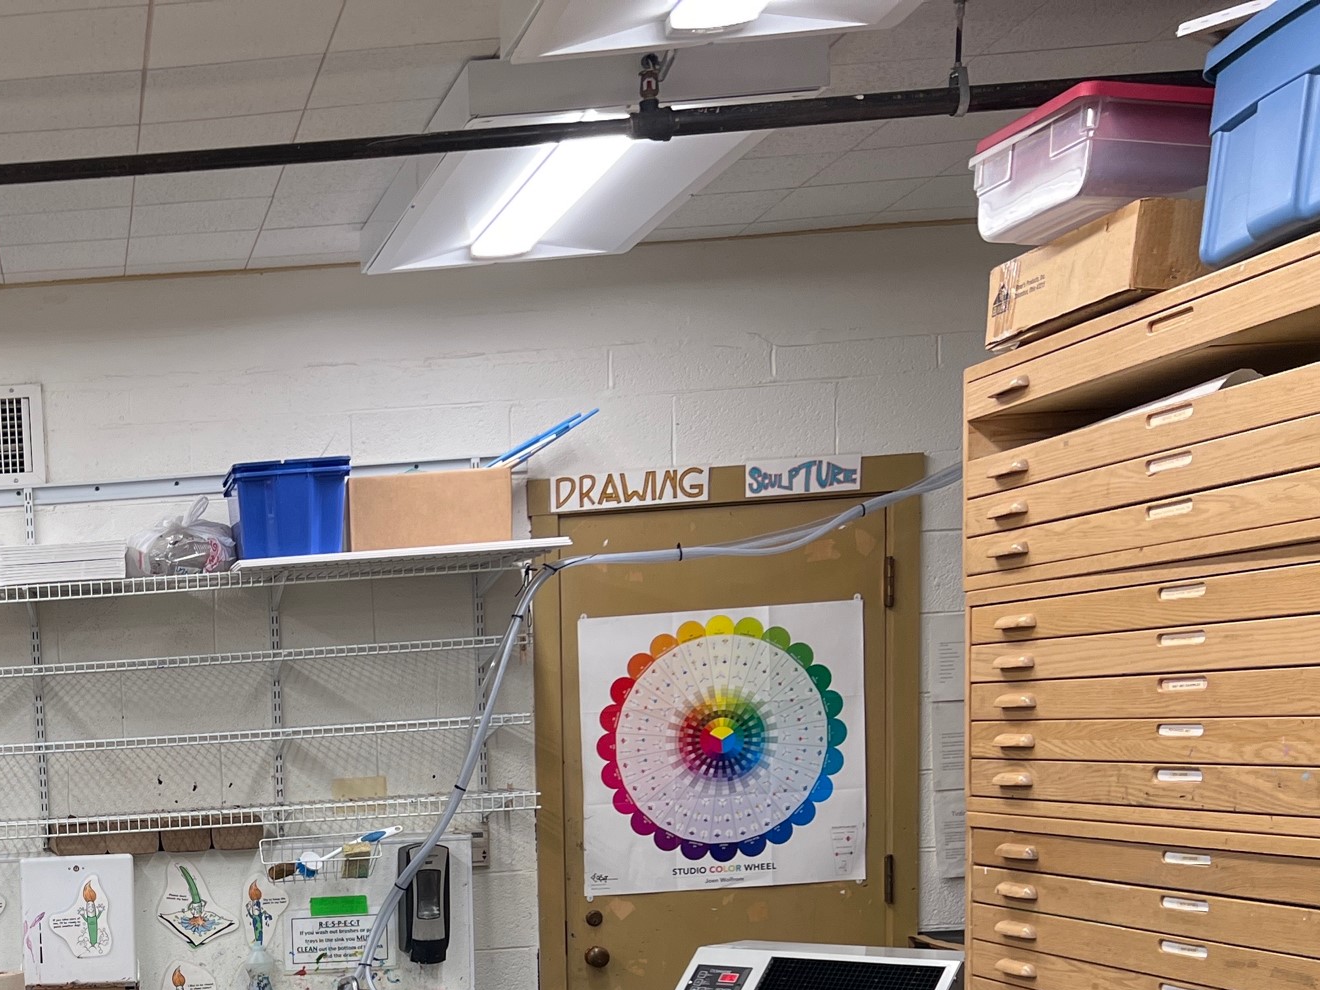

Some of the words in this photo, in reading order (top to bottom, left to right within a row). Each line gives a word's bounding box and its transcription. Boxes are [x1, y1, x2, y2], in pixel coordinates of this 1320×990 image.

[555, 466, 704, 510] DRAWING
[748, 460, 858, 494] SCULPTURE
[672, 866, 707, 876] STUDIO
[709, 865, 741, 874] COLOR
[744, 862, 777, 872] WHEEL
